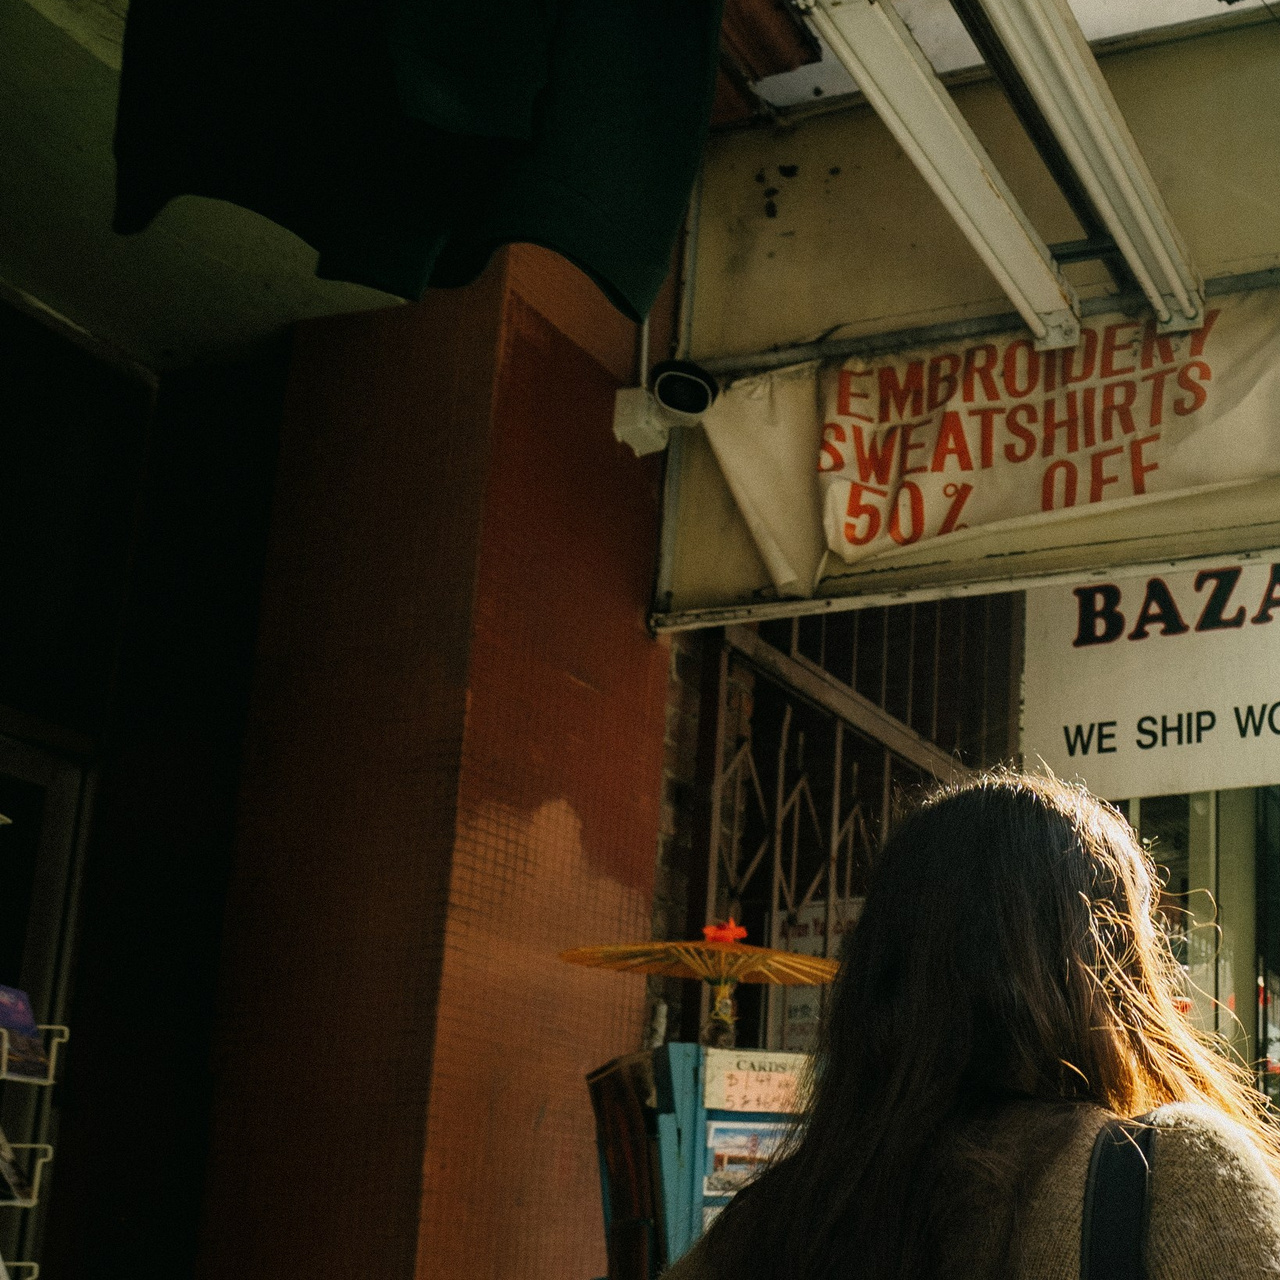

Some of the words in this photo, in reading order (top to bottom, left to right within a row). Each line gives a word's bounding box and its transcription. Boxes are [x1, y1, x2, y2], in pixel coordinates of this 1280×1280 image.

[837, 309, 1222, 422] EMBROIDERY
[818, 360, 1212, 486] SWEATSHIRTS
[844, 482, 974, 546] 50%
[1041, 434, 1161, 512] OFF
[1063, 720, 1117, 757] WE
[1136, 711, 1216, 750] SHIP
[736, 1059, 788, 1072] CARDS
